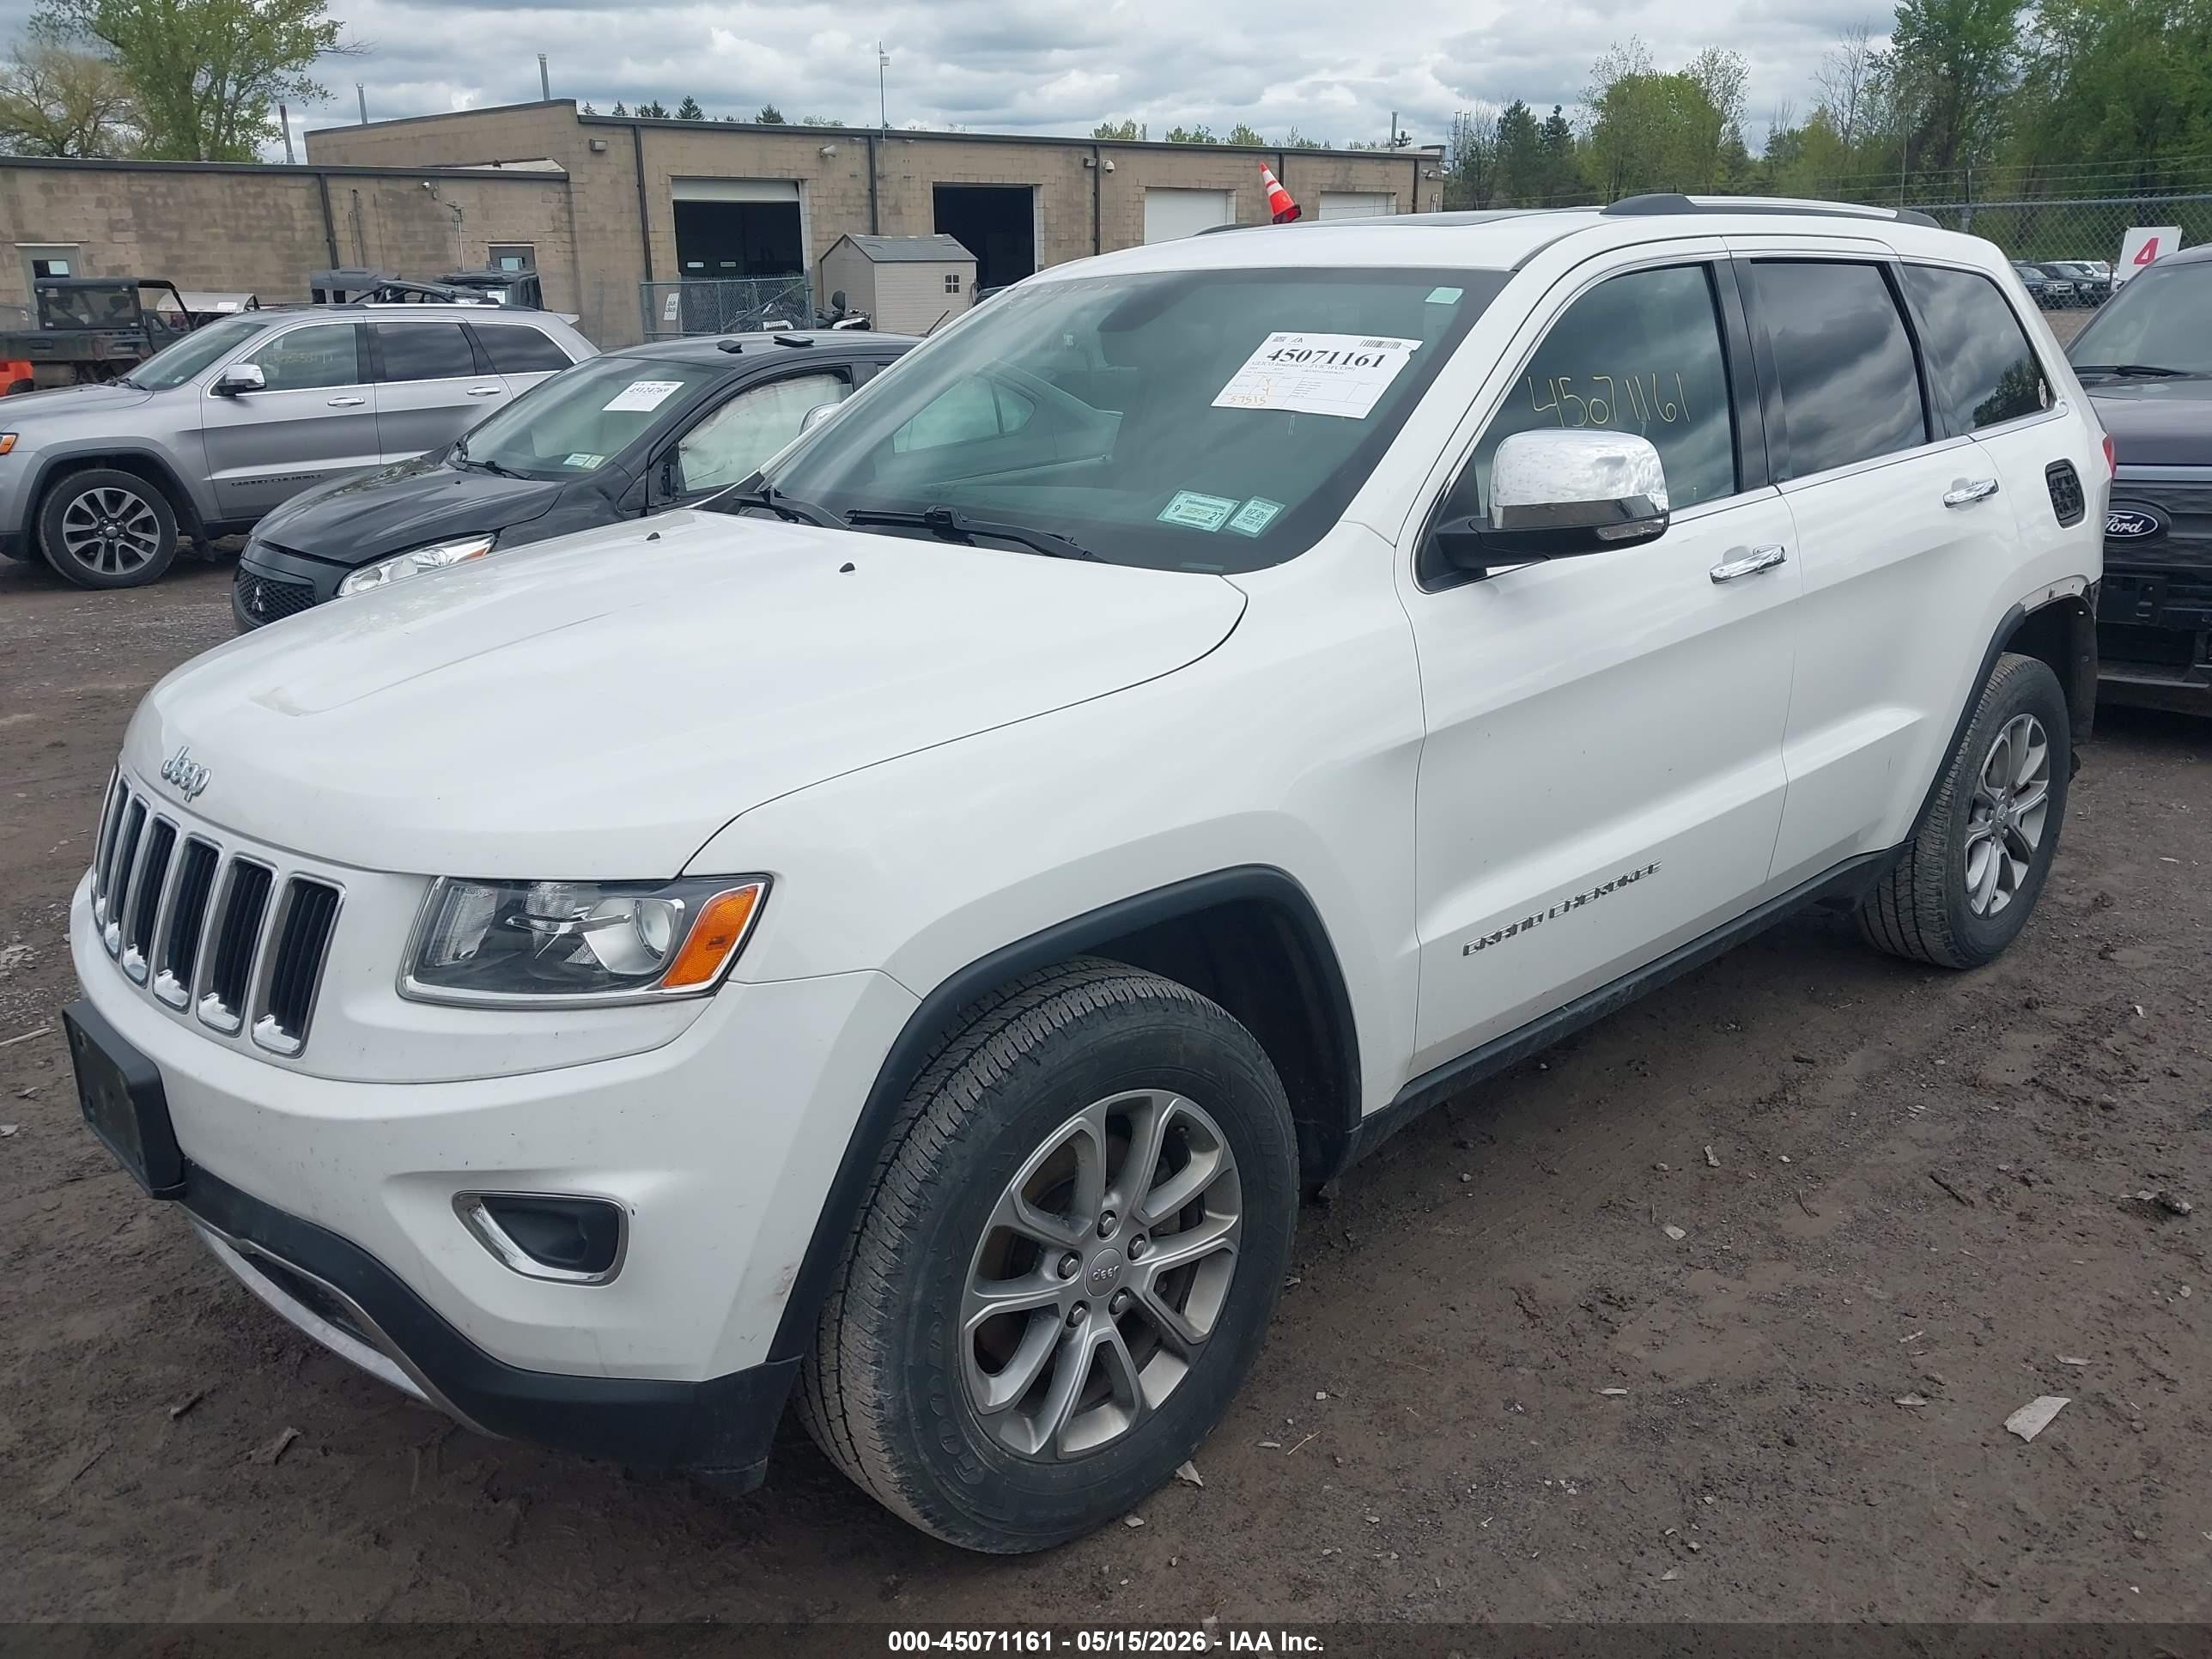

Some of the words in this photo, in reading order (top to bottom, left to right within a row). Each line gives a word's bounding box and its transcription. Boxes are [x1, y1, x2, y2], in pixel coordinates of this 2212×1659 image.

[2133, 237, 2160, 264] 4
[1267, 348, 1387, 368] 45071161
[1527, 372, 1691, 428] 45071161
[1208, 511, 1224, 521] 27
[2105, 514, 2146, 533] Ford
[161, 746, 211, 804] Jeep
[1462, 910, 1545, 957] GRAND
[1548, 859, 1662, 920] CHEROKEE
